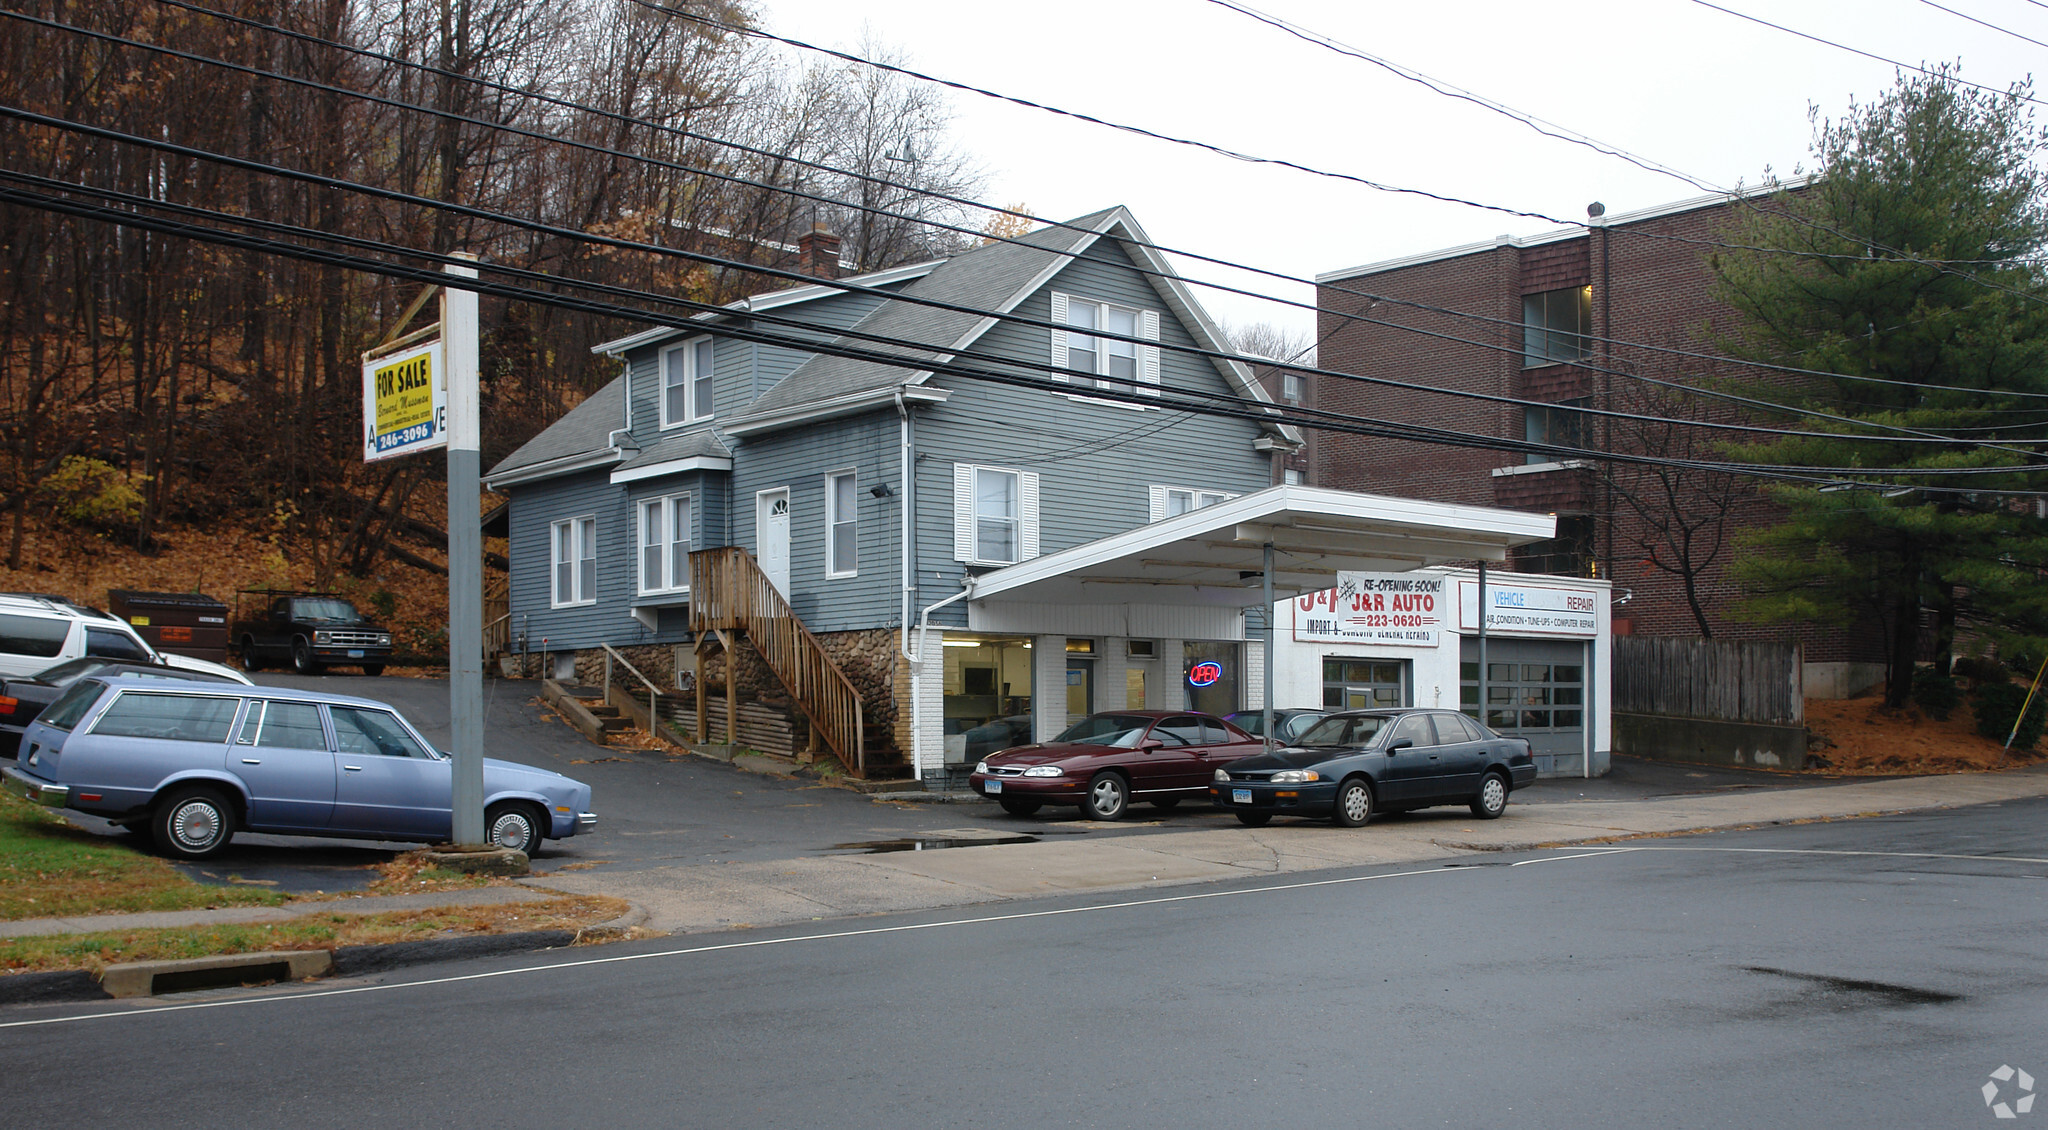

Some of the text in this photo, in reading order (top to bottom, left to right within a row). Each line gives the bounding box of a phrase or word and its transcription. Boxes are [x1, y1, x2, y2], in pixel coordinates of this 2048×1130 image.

[377, 359, 427, 399] FOR SALE
[380, 424, 428, 449] 246-3096
[1364, 579, 1442, 593] RE-OPENING SOON!
[1351, 593, 1434, 612] J&R AUTO
[1494, 591, 1594, 611] VEHICLE REPAIR
[1307, 619, 1331, 636] IMPORT
[1367, 615, 1422, 627] 223-0620
[1486, 614, 1595, 630] AIR CONDITION TUNE-UPS COMPUTER REPAIR
[1191, 665, 1219, 682] OPEN
